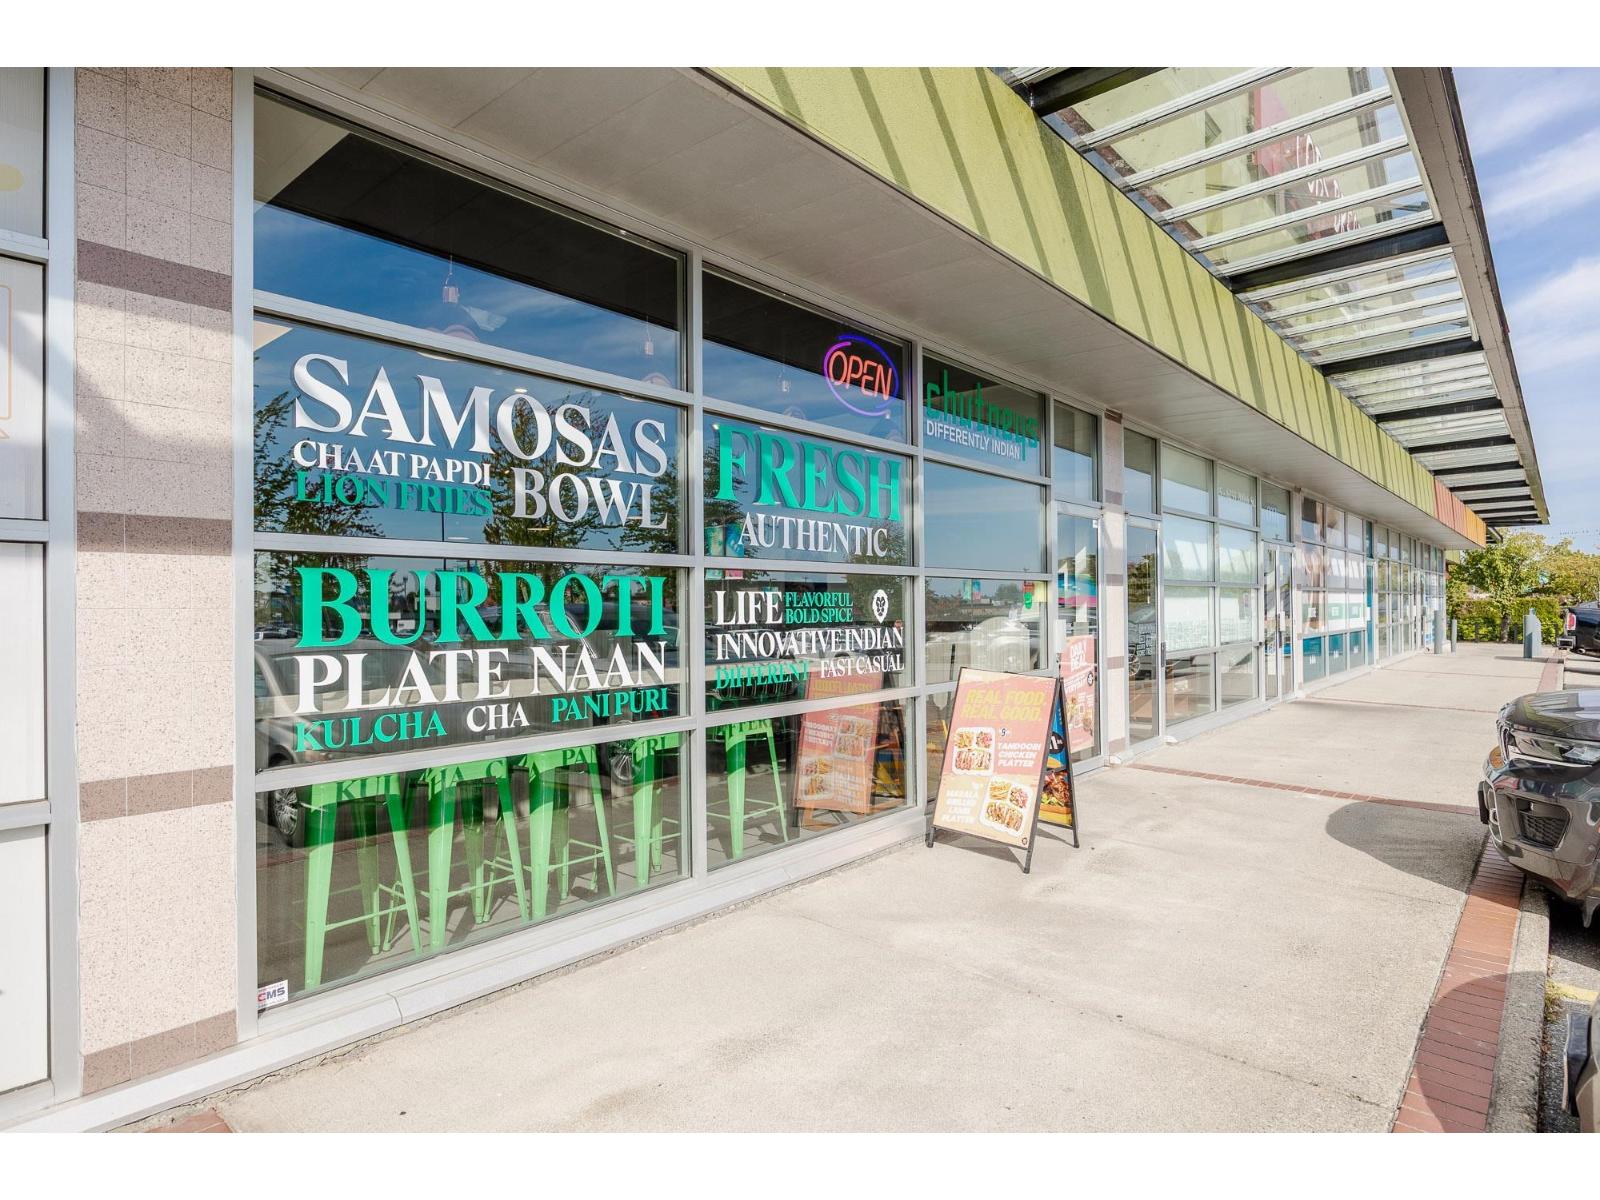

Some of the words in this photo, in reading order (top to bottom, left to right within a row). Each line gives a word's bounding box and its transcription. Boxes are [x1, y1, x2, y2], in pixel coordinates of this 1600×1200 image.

[827, 350, 893, 401] OPEN
[293, 353, 668, 477] SAMOSAS
[926, 368, 1039, 461] chutneys
[926, 420, 989, 451] DIFFERENTLY
[991, 439, 1020, 460] INDIAN
[292, 440, 405, 476] CHAAT
[411, 454, 491, 487] PAPDI
[714, 424, 902, 521] FRESH
[296, 471, 391, 508] LION
[397, 481, 493, 516] FRIES
[510, 466, 668, 530] BOWL
[737, 511, 888, 557] AUTHENTIC
[294, 566, 668, 648] BURROTI
[715, 590, 784, 626] LIFE
[785, 591, 853, 608] FLAVORFUL
[785, 608, 820, 625] BOLD
[821, 608, 853, 623] SPICE
[716, 629, 842, 661] INNOVATIVE
[843, 627, 904, 651] INDIAN
[295, 647, 511, 714] PLATE
[530, 641, 667, 694] NAAN
[715, 660, 810, 690] DIFFERENT
[820, 656, 854, 679] FAST
[856, 653, 905, 675] CASUAL
[551, 693, 610, 723] PANI
[611, 688, 669, 716] PURI
[961, 703, 996, 719] REAL
[966, 688, 1000, 704] REAL
[295, 709, 448, 753] KULCHA
[465, 700, 530, 733] CHA
[257, 986, 286, 1002] CMS
